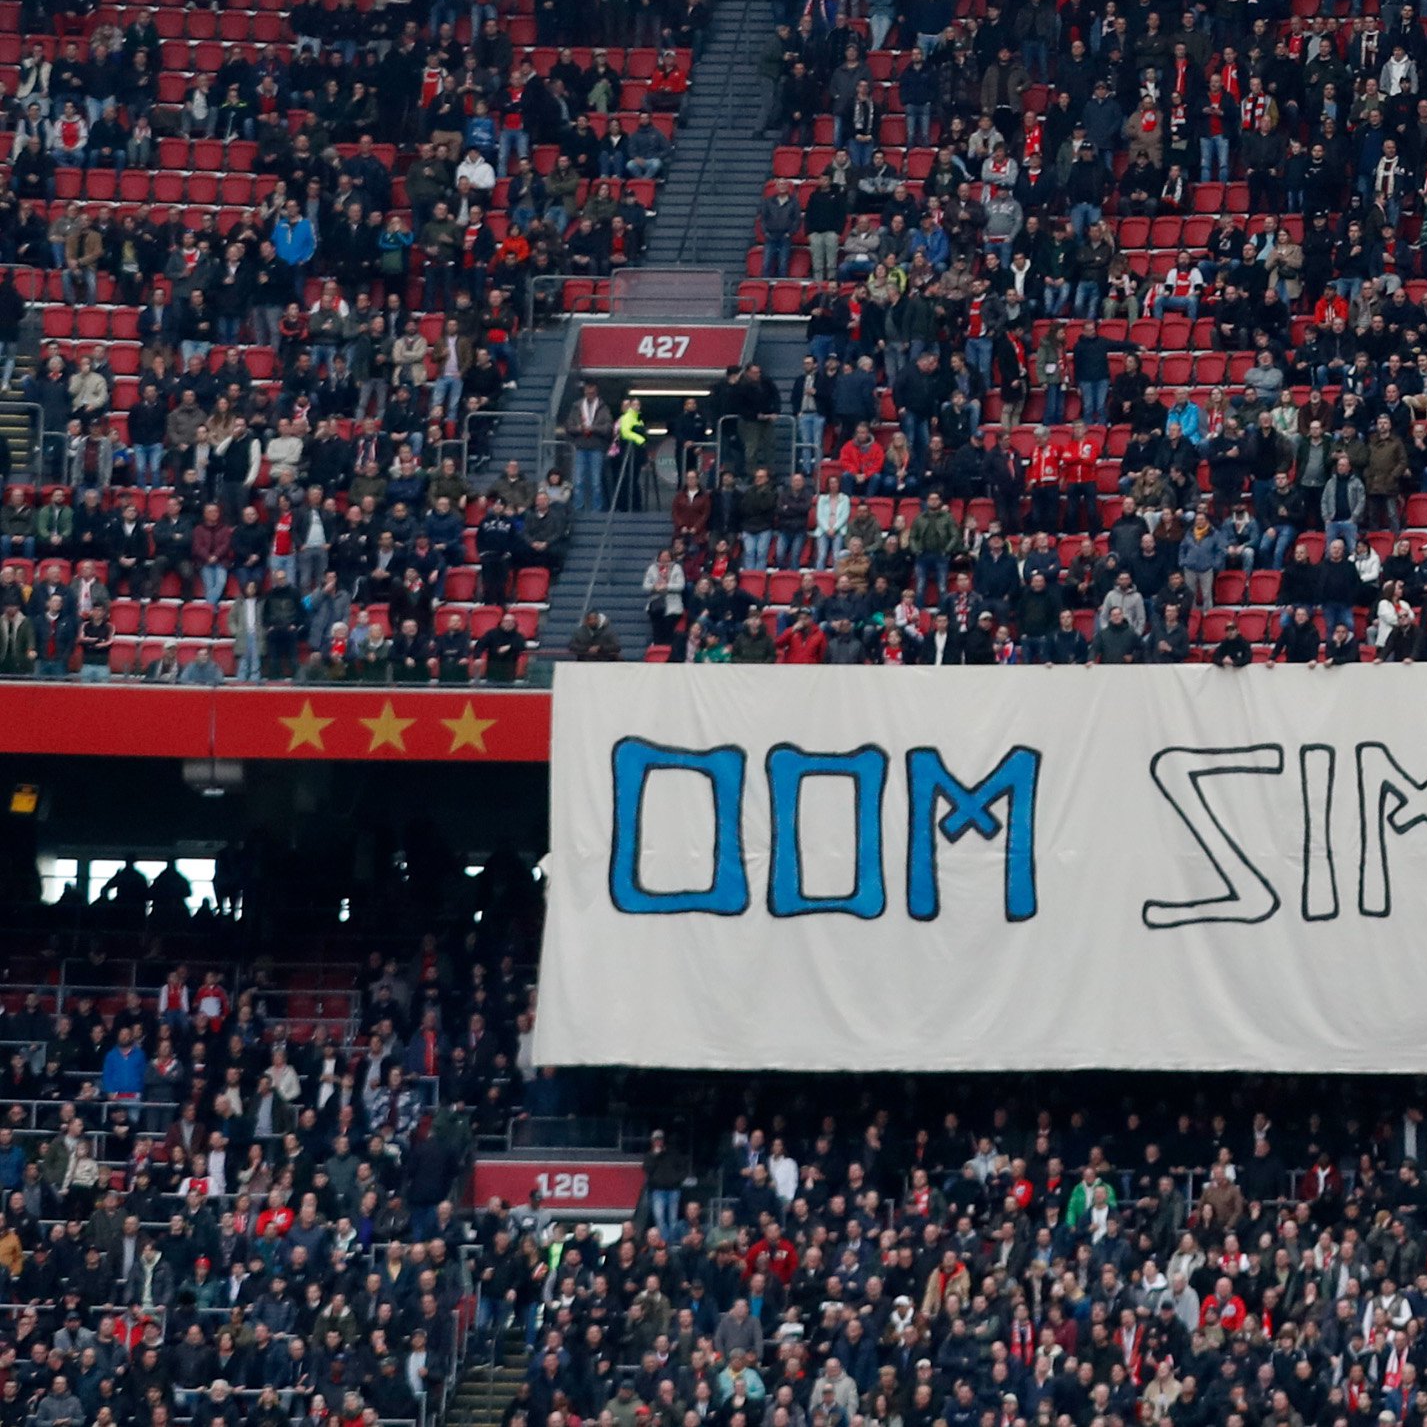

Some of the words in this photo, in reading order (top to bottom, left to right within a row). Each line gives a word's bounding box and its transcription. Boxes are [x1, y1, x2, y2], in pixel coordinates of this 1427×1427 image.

[637, 335, 690, 359] 427
[609, 735, 1042, 921] OOM
[536, 1173, 590, 1199] 126
